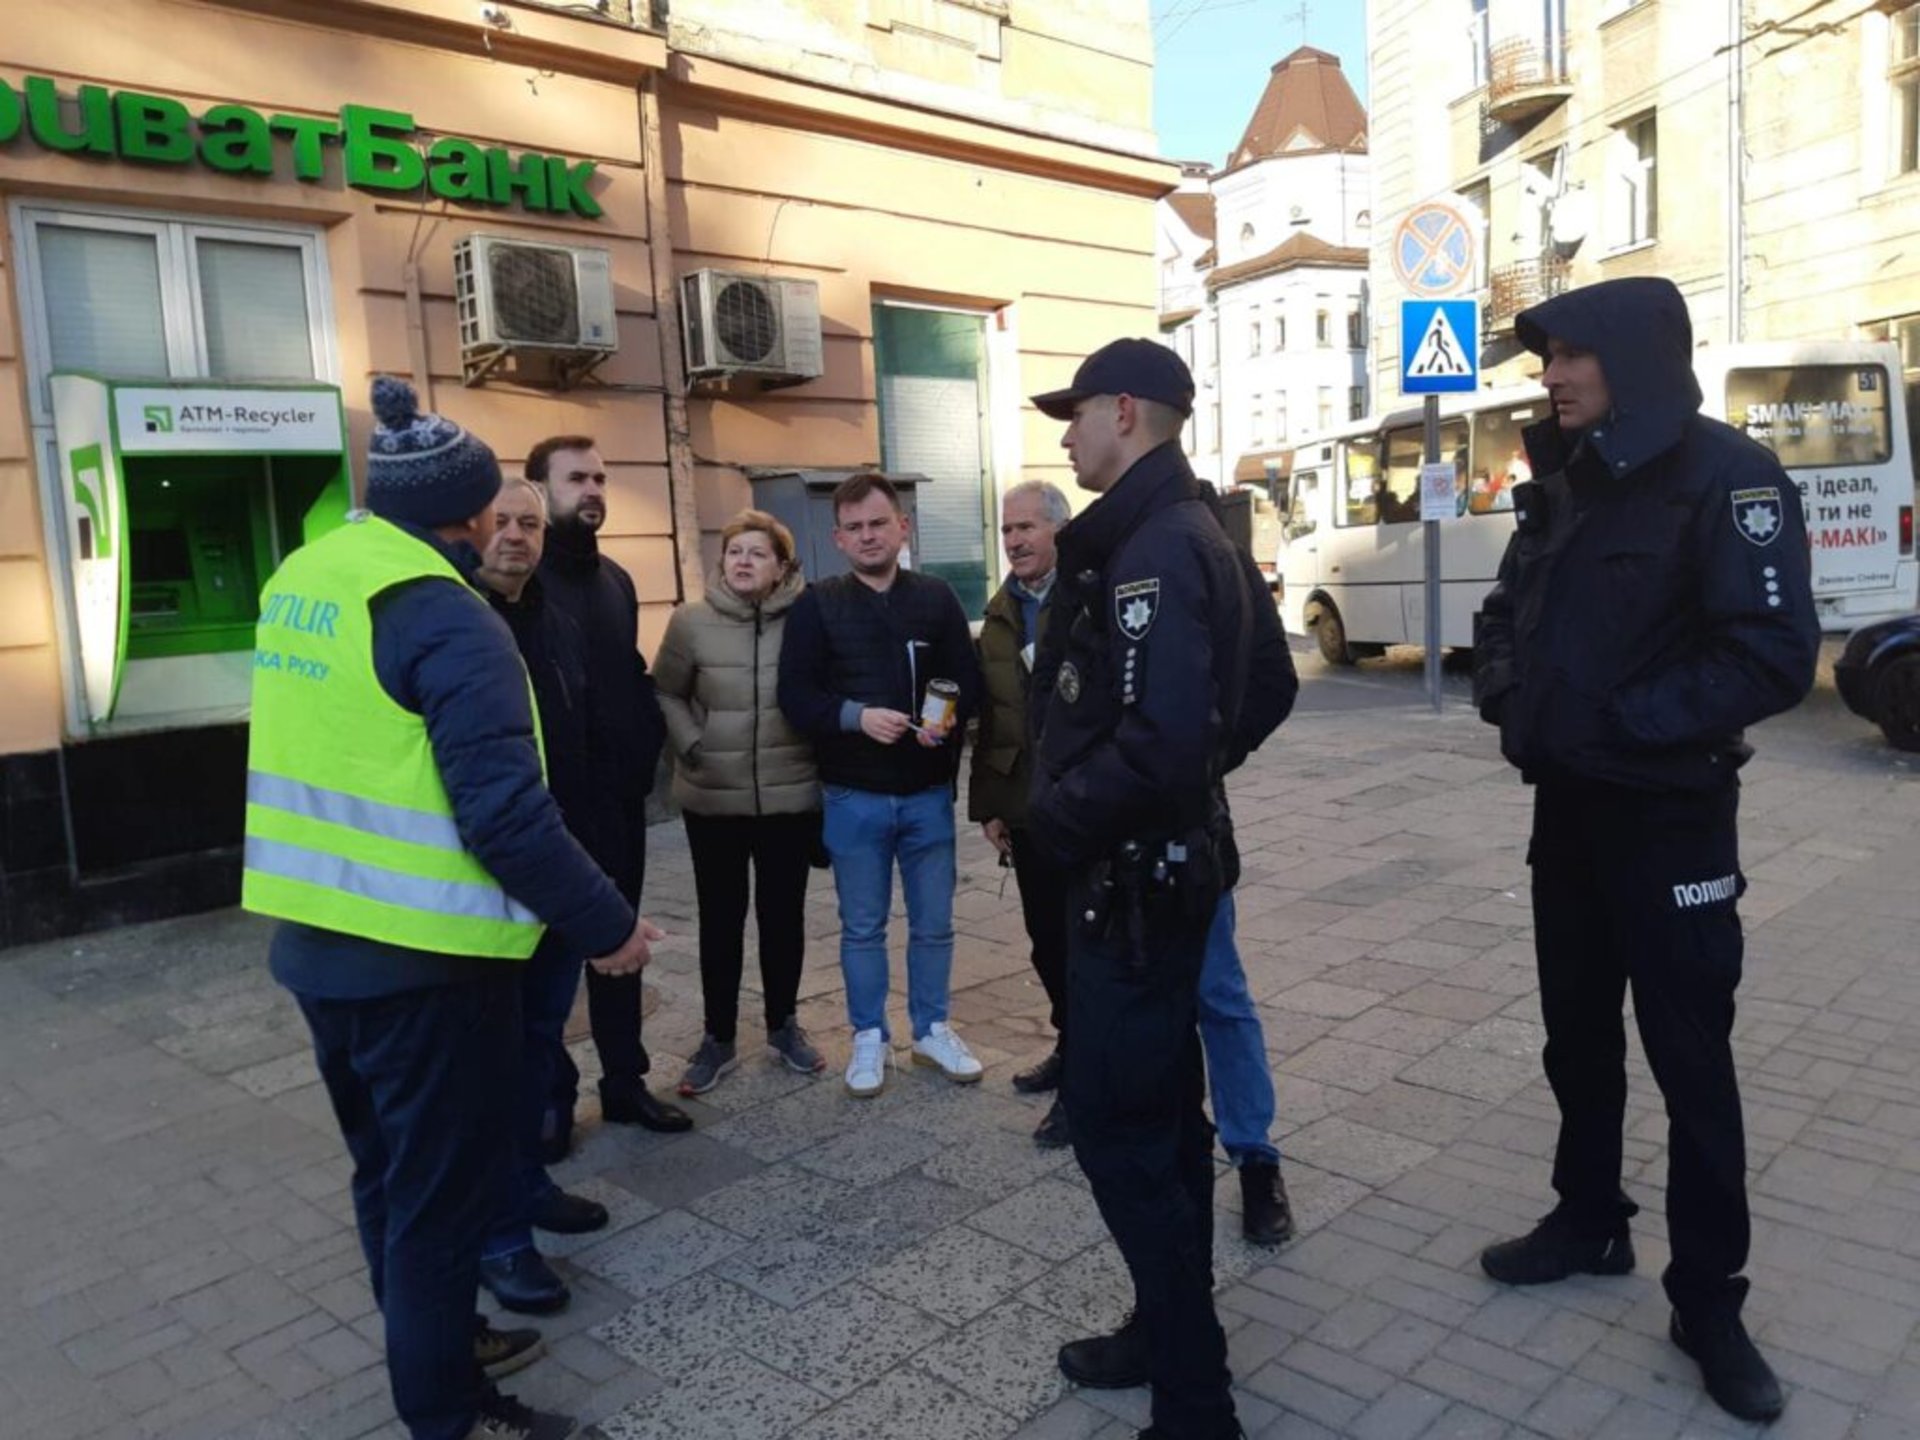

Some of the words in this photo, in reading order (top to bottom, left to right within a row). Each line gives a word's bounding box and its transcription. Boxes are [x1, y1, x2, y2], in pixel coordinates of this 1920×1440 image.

[180, 406, 316, 427] ATM-Recycler
[1816, 475, 1879, 499] ідеал,
[1818, 506, 1841, 521] ти
[1847, 503, 1872, 520] не
